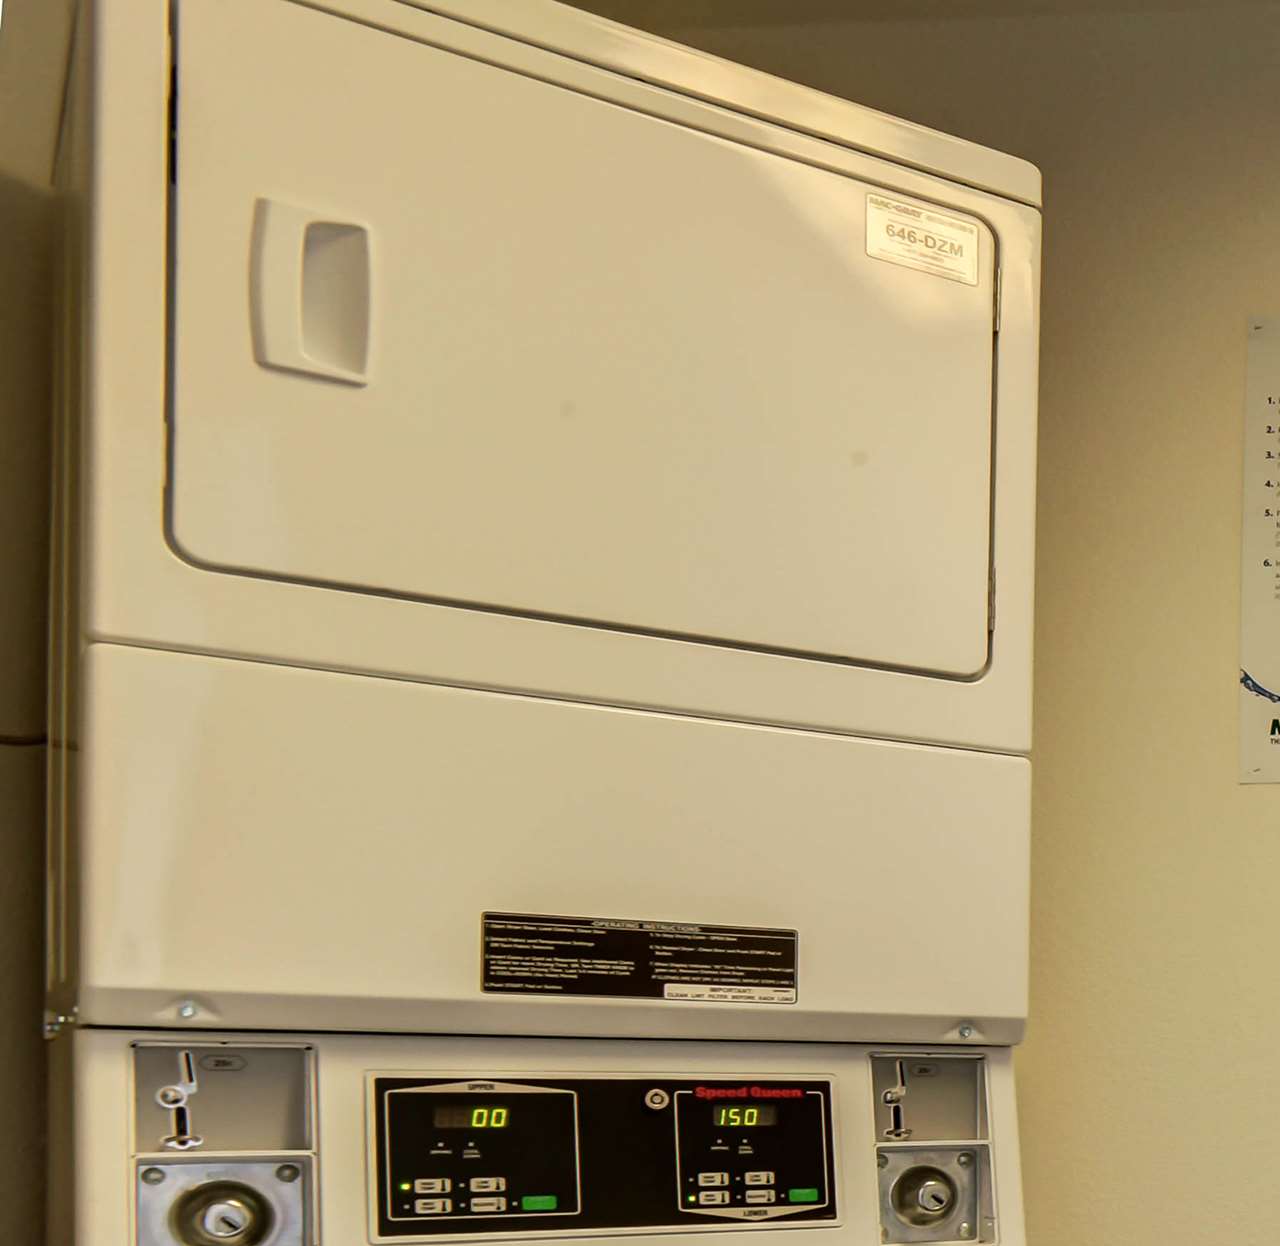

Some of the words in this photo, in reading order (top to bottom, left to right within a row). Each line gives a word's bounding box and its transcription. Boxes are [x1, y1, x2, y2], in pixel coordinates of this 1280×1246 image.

[886, 224, 963, 257] 646-DZM
[1268, 397, 1275, 405] 1.
[1265, 451, 1275, 459] 3.
[1265, 509, 1273, 517] 5.
[1263, 559, 1272, 567] 6.
[695, 1087, 748, 1100] Speed
[751, 1087, 803, 1098] Queen
[471, 1109, 507, 1127] 00
